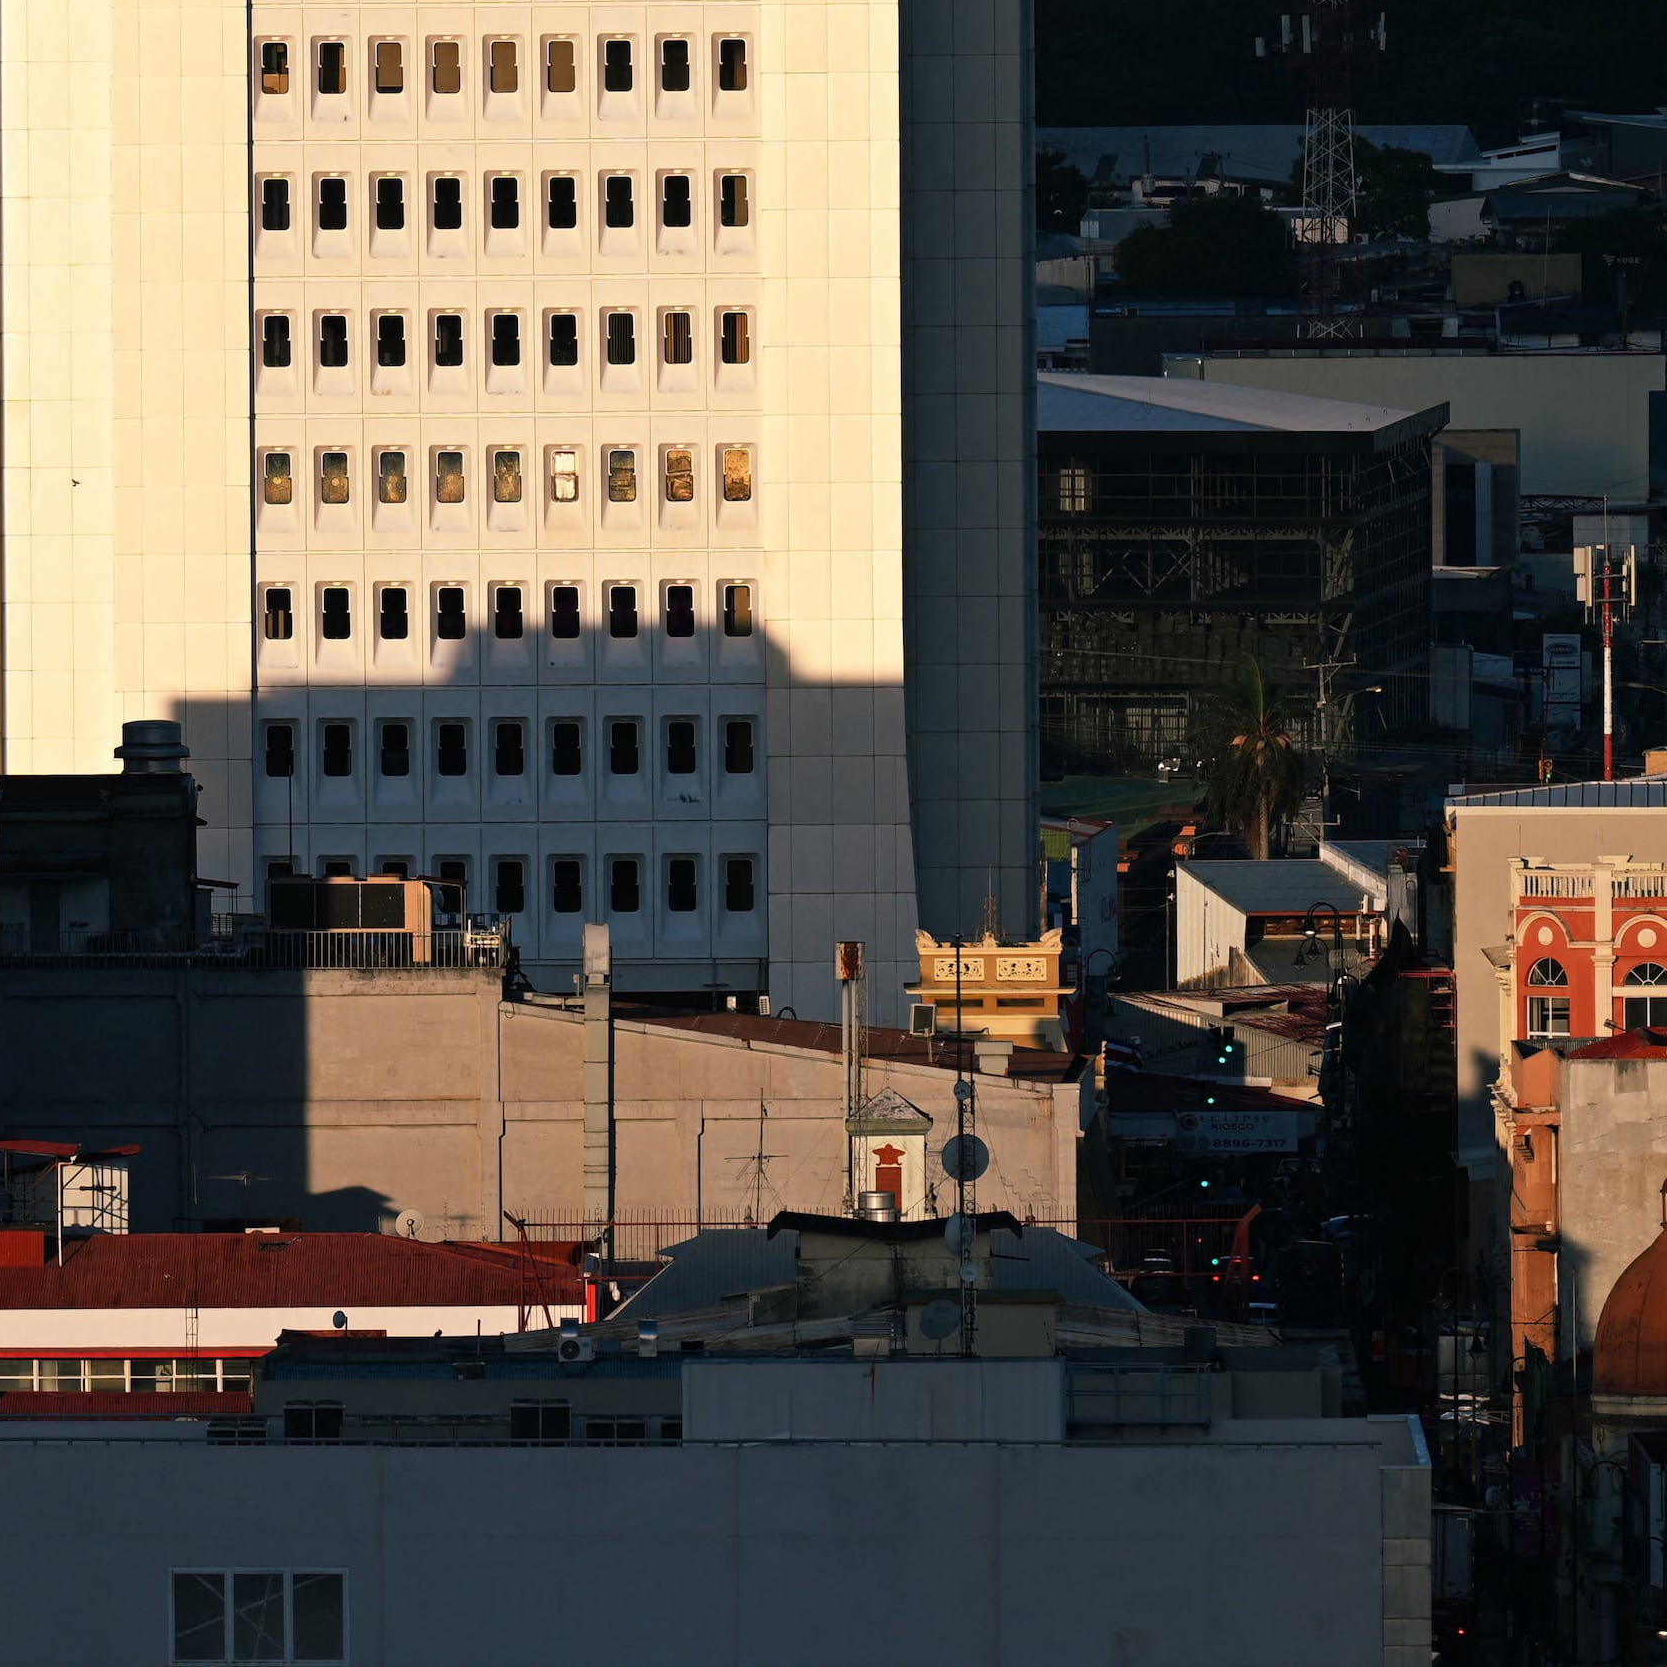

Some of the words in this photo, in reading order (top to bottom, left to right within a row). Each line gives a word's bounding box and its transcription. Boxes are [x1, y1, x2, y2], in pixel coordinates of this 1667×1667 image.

[1200, 1114, 1273, 1123] ECLIPSE
[1211, 1123, 1255, 1131] KIOSCO
[1212, 1139, 1287, 1148] 8896-7317
